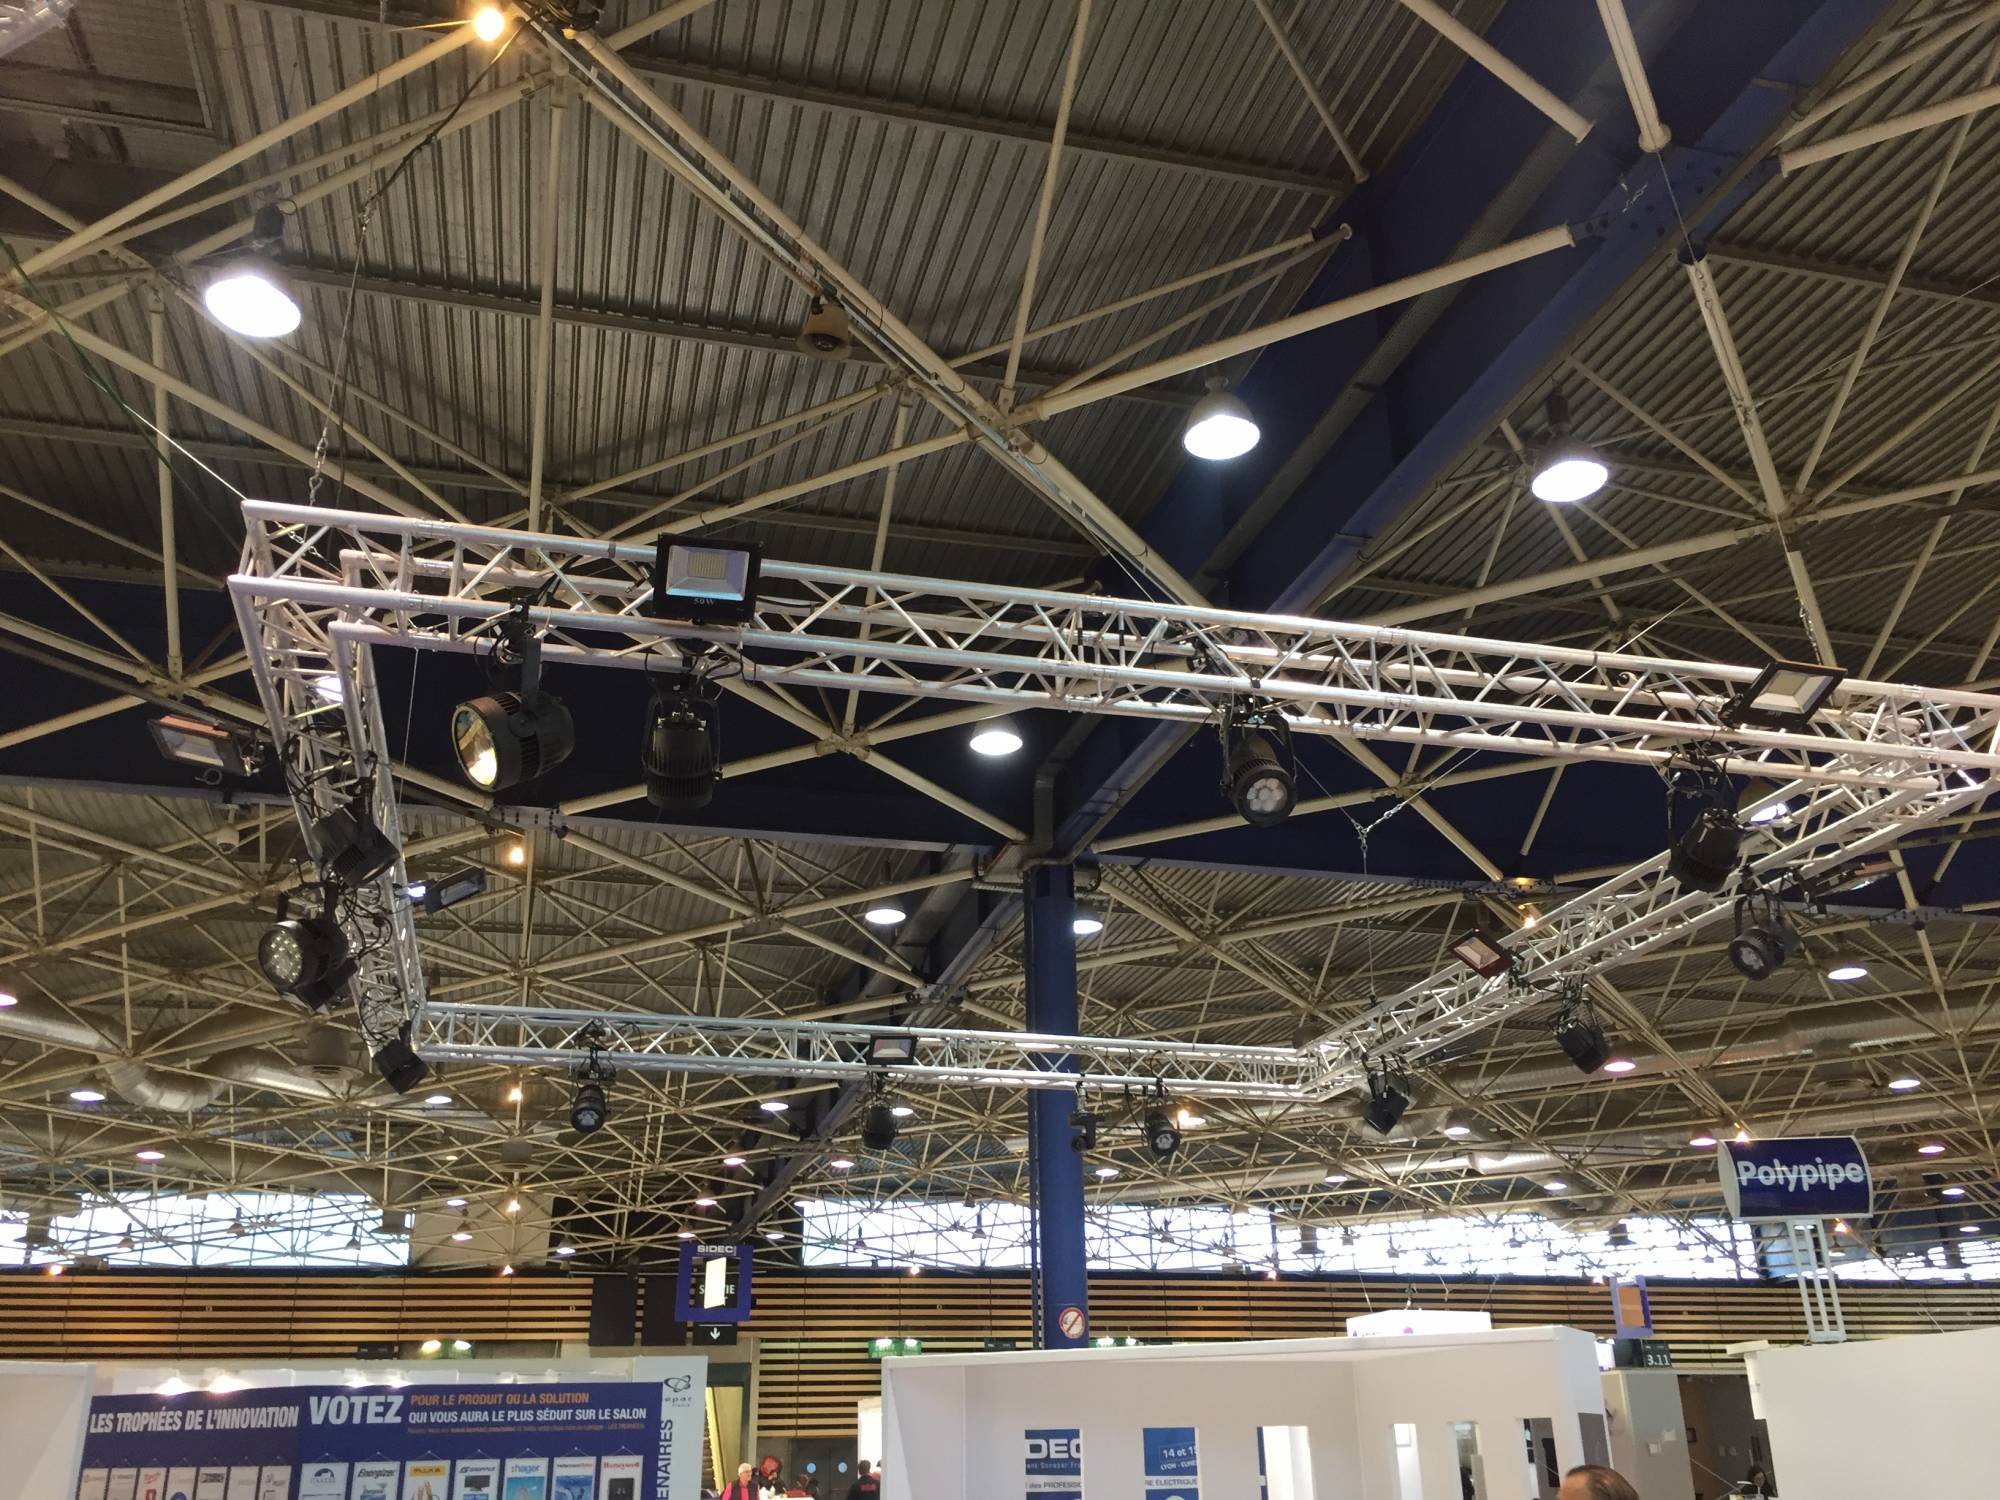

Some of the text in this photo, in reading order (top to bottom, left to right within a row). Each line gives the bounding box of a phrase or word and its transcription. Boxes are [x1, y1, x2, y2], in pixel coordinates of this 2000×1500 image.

[1737, 1157, 1865, 1192] Polypipe
[697, 1245, 734, 1253] SIDEC
[1647, 1354, 1670, 1366] 3.11
[411, 1392, 589, 1406] POUR LE PRODUIT OU LA SOLUTION
[309, 1395, 404, 1425] VOTEZ
[409, 1407, 647, 1424] QUI VOUS AURA LE PLUS SÉDUIT SUR LE SALON
[89, 1406, 300, 1433] LES TROPHÉES DE L'INNOVATION
[1163, 1448, 1176, 1458] 14
[1177, 1448, 1187, 1457] et
[1160, 1462, 1177, 1471] LYON
